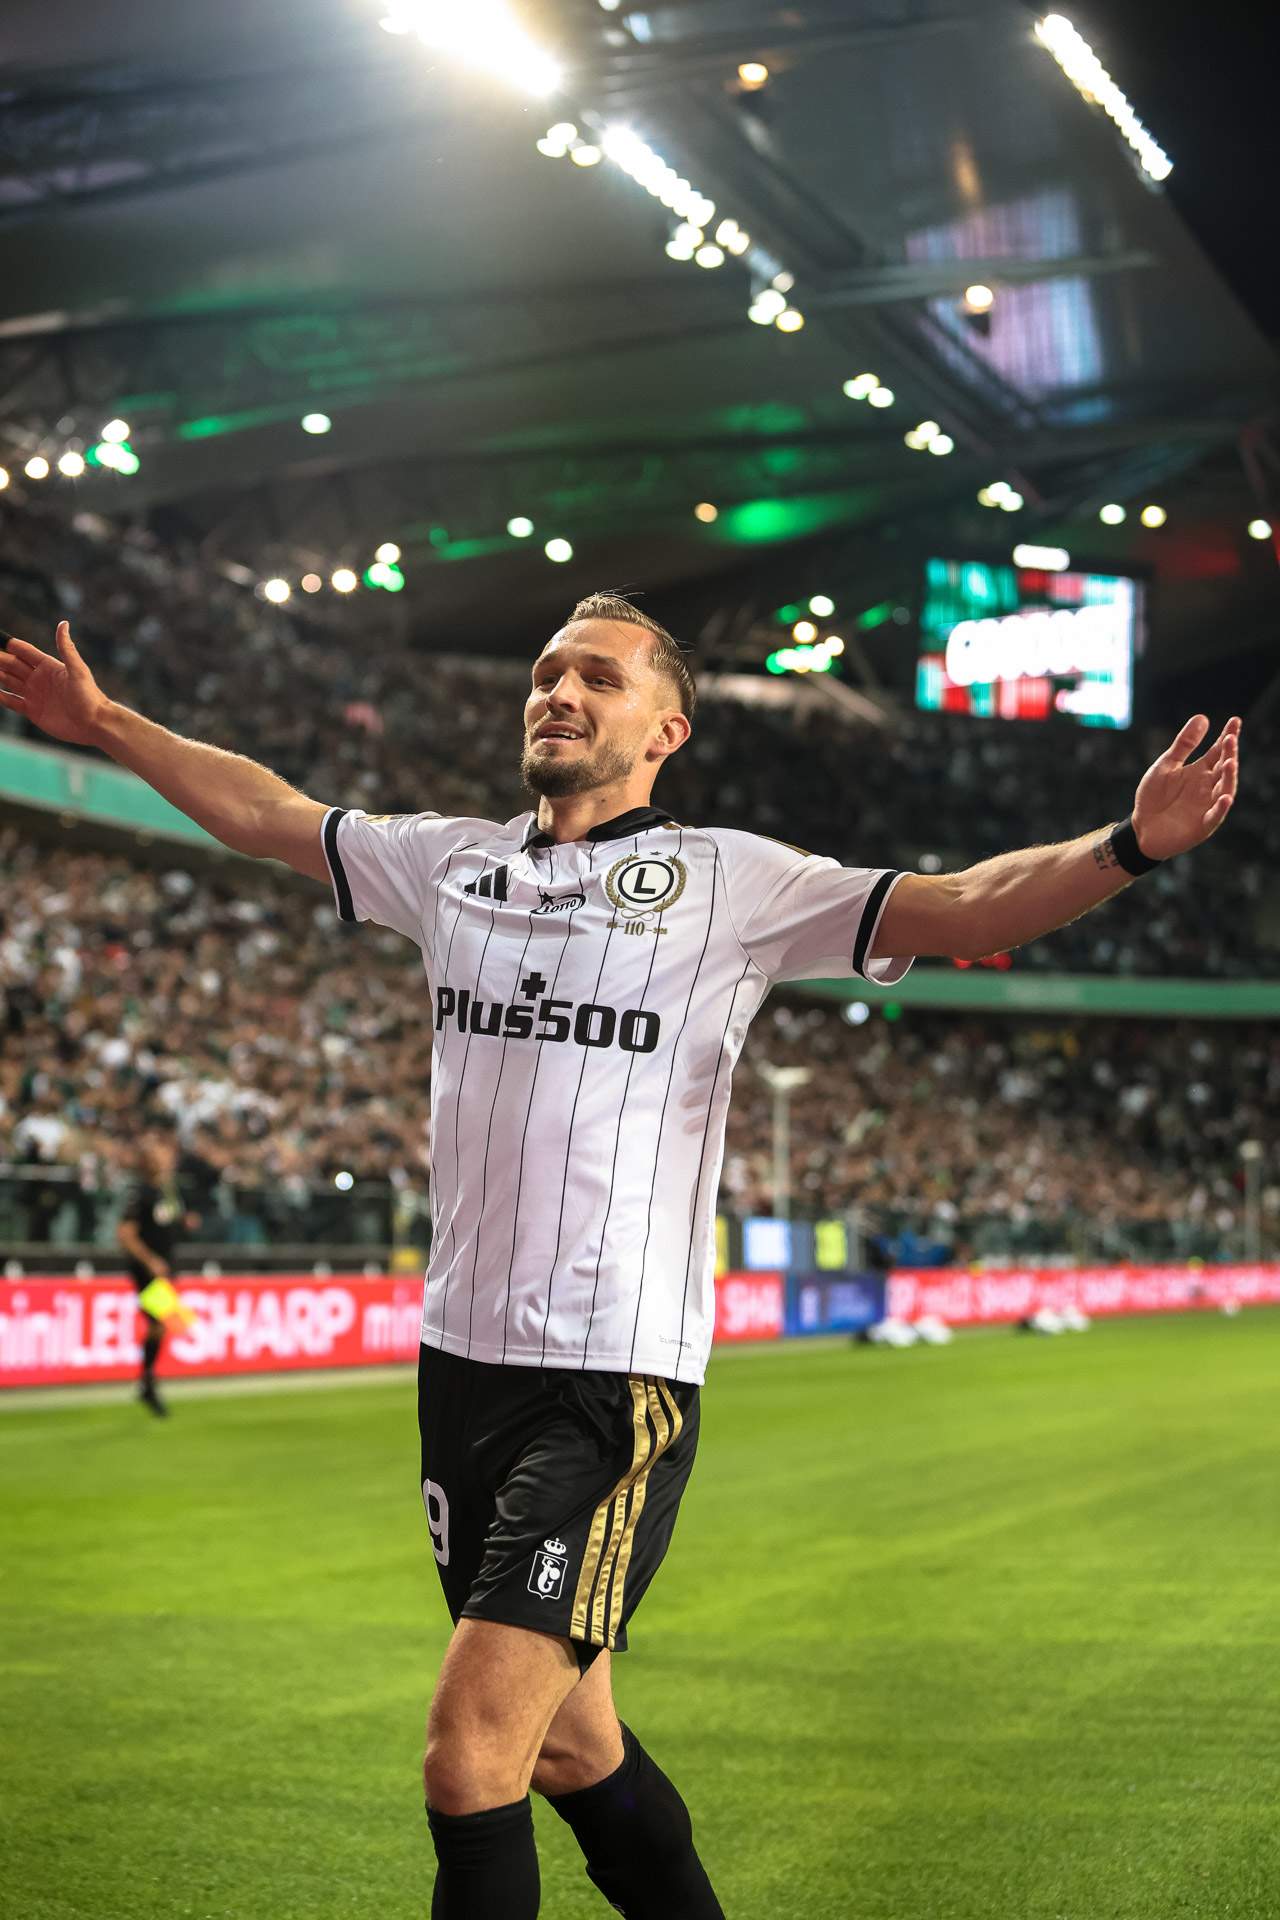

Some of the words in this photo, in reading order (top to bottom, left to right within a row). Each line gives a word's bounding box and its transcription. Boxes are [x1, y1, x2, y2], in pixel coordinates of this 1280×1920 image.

[633, 867, 657, 895] L
[543, 898, 577, 913] LOTTO
[624, 920, 645, 937] 110
[436, 986, 661, 1053] Plus500
[171, 1288, 357, 1364] SHARP
[422, 1478, 450, 1566] 9
